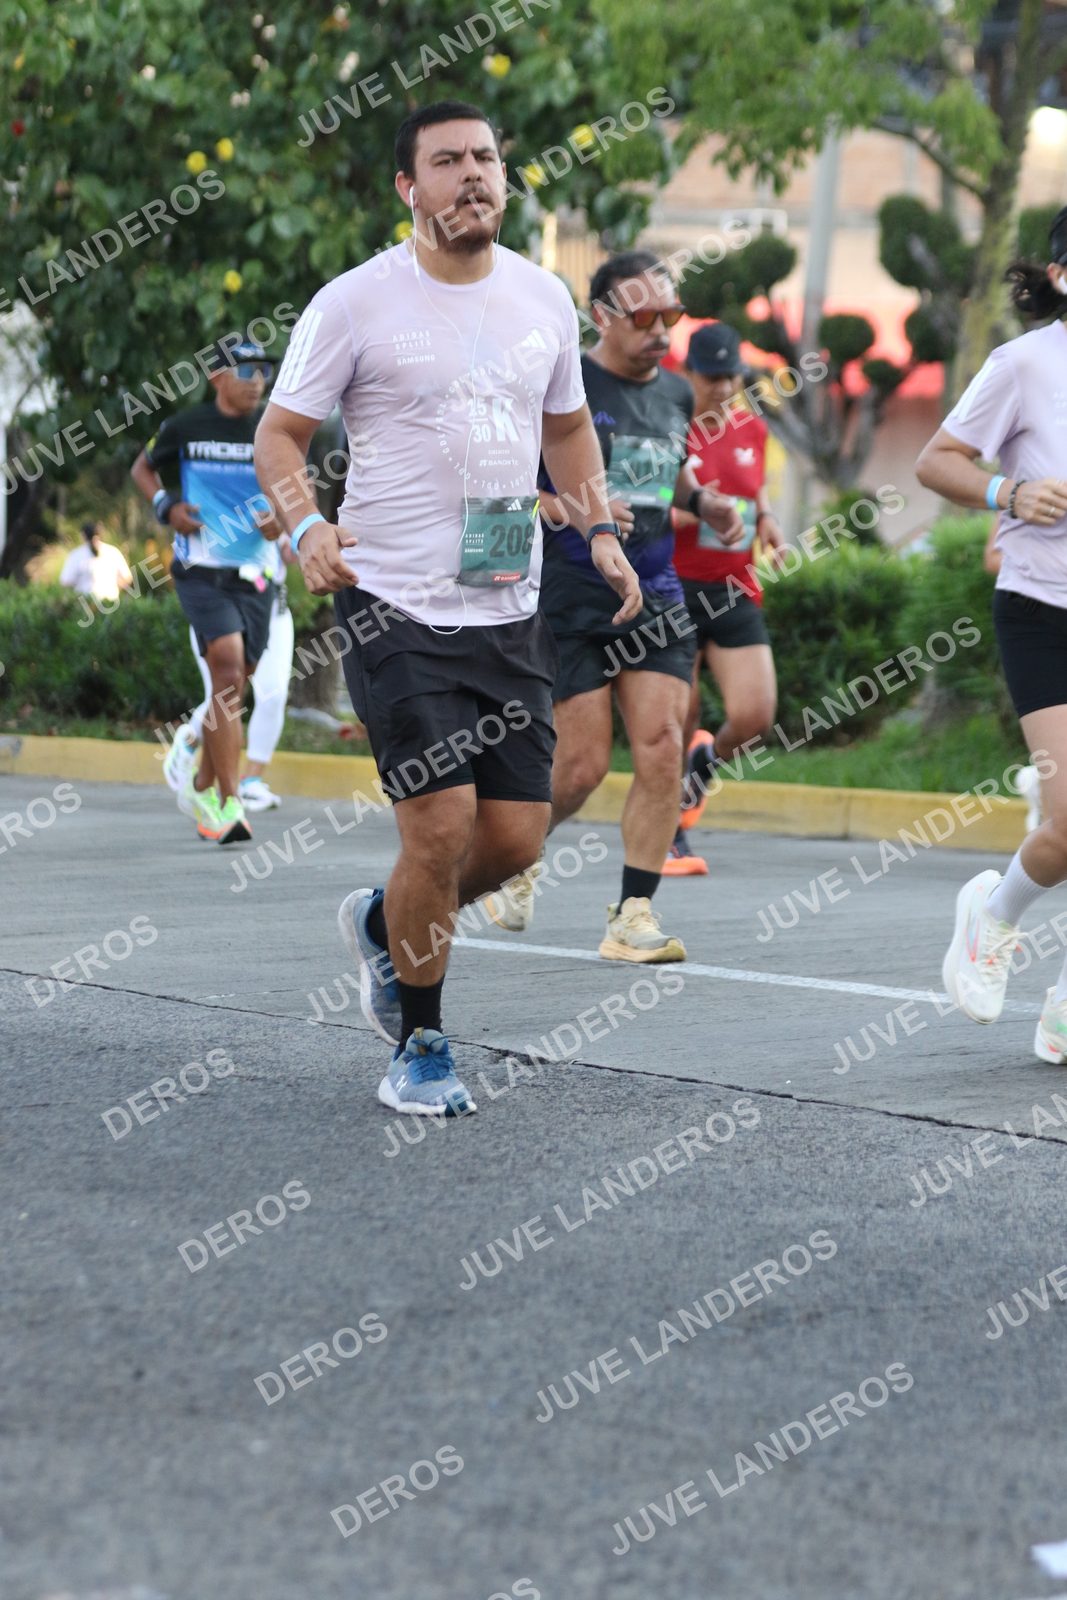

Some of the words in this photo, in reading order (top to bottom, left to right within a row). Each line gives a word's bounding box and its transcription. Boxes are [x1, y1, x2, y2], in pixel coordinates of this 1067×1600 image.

[467, 398, 487, 417] 25
[492, 398, 520, 441] K
[473, 423, 491, 443] 30
